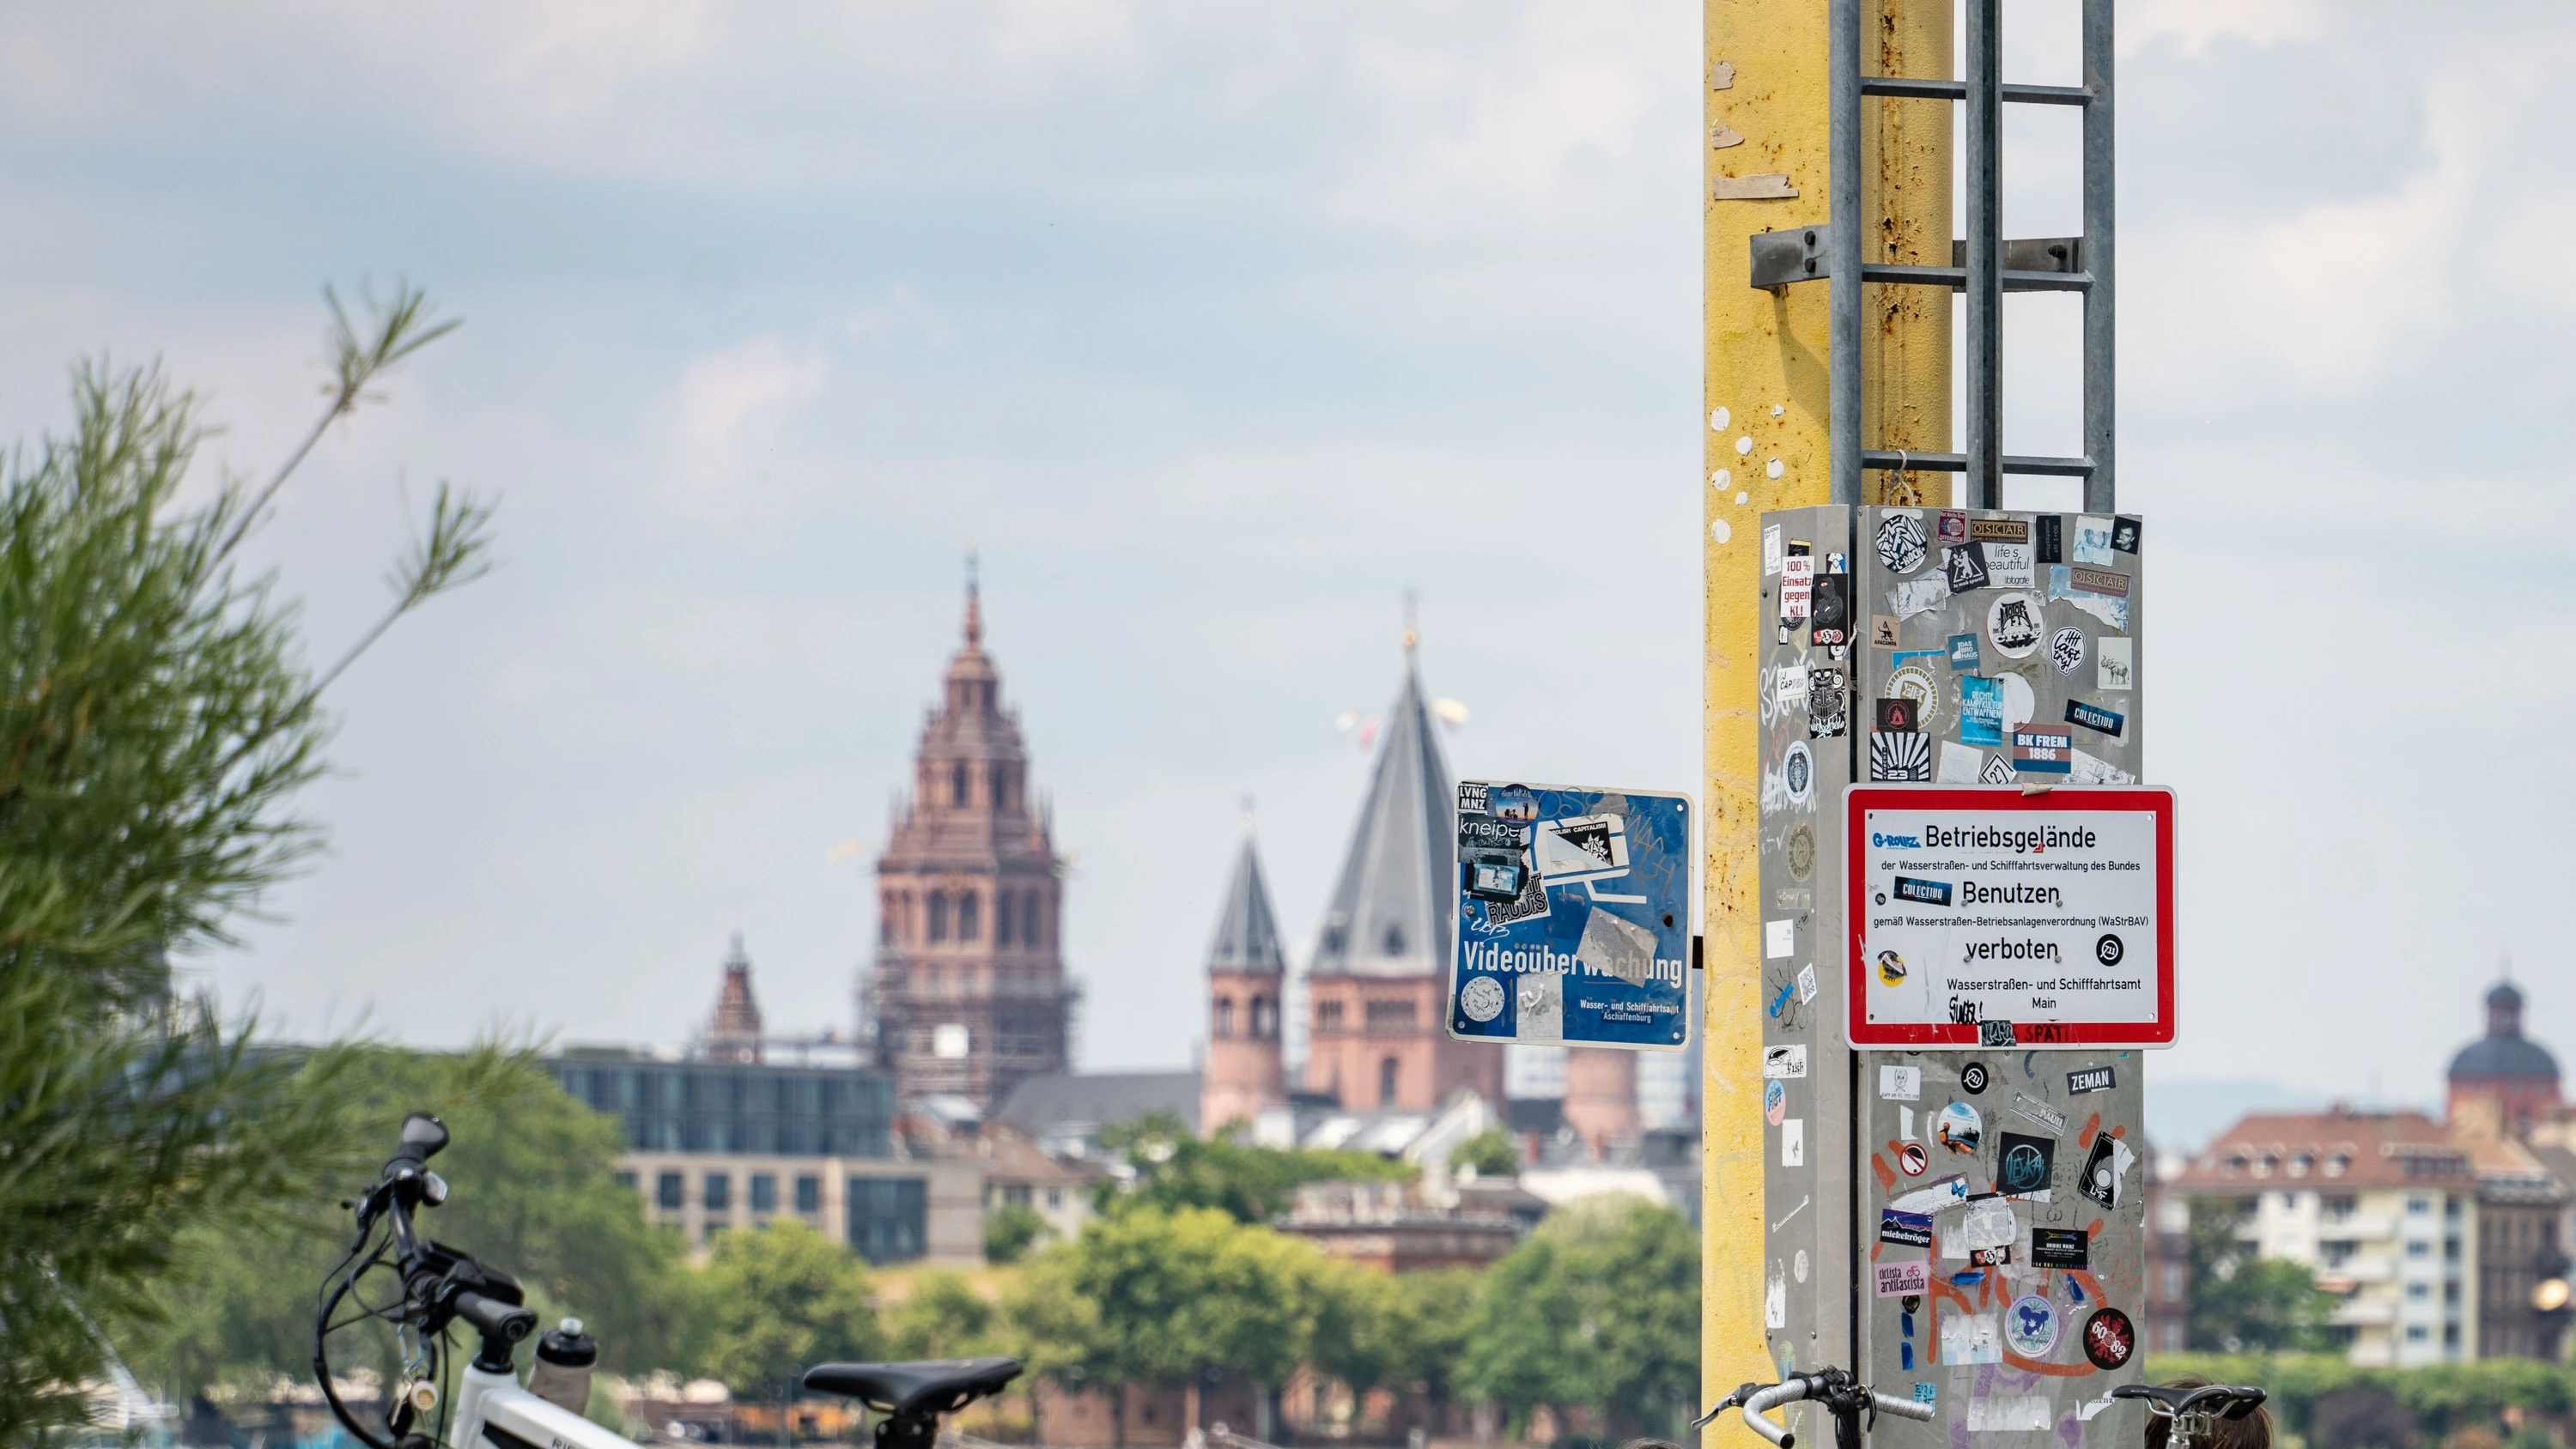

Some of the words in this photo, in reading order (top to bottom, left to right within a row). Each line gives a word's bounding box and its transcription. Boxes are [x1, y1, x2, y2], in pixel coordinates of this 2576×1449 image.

[1973, 524, 2024, 535] OSCAR
[1895, 548, 1923, 570] C-ROCK
[1786, 561, 1801, 572] 100
[1803, 561, 1810, 571] %
[1782, 576, 1812, 587] Einsatz
[2075, 572, 2125, 588] OSCAR
[1784, 591, 1810, 603] gegen
[1971, 691, 1994, 700] RECHTE
[2017, 734, 2033, 746] BK
[2036, 735, 2068, 748] FREM
[2028, 749, 2057, 761] 1886
[1887, 770, 1908, 780] 23
[1460, 786, 1487, 798] LVNG
[1461, 798, 1485, 809] MNZ
[1573, 822, 1607, 833] CAPITALISM
[1925, 825, 2096, 852] Betriebsgelände
[1881, 861, 1896, 870] der
[1899, 860, 1969, 870] Wasserstraßen-
[1971, 861, 1988, 870] und
[1990, 861, 2088, 873] Schifffahrtsverwaltung
[2091, 861, 2105, 870] des
[2108, 862, 2141, 871] Bundes
[1963, 881, 2060, 904] Benutzen
[1874, 916, 1904, 929] gemäß
[1905, 916, 2096, 929] Wasserstraßen-Betriebsanlagenverordnung
[2099, 916, 2149, 927] (WaStrBAV)
[1966, 937, 2058, 960] verboten
[1947, 979, 2033, 991] Wasserstraßen-
[2037, 979, 2056, 991] und
[2059, 979, 2142, 991] Schifffahrtsamt
[1580, 999, 1607, 1009] Wasser-
[1611, 1000, 1623, 1010] und
[2032, 997, 2057, 1009] Main
[1603, 1012, 1652, 1024] Aschaffenburg
[2071, 1070, 2110, 1091] ZEMAN
[1879, 1267, 1902, 1280] ciclista
[1880, 1276, 1925, 1293] antifascista
[2092, 1321, 2107, 1339] 60
[2110, 1340, 2127, 1360] 82
